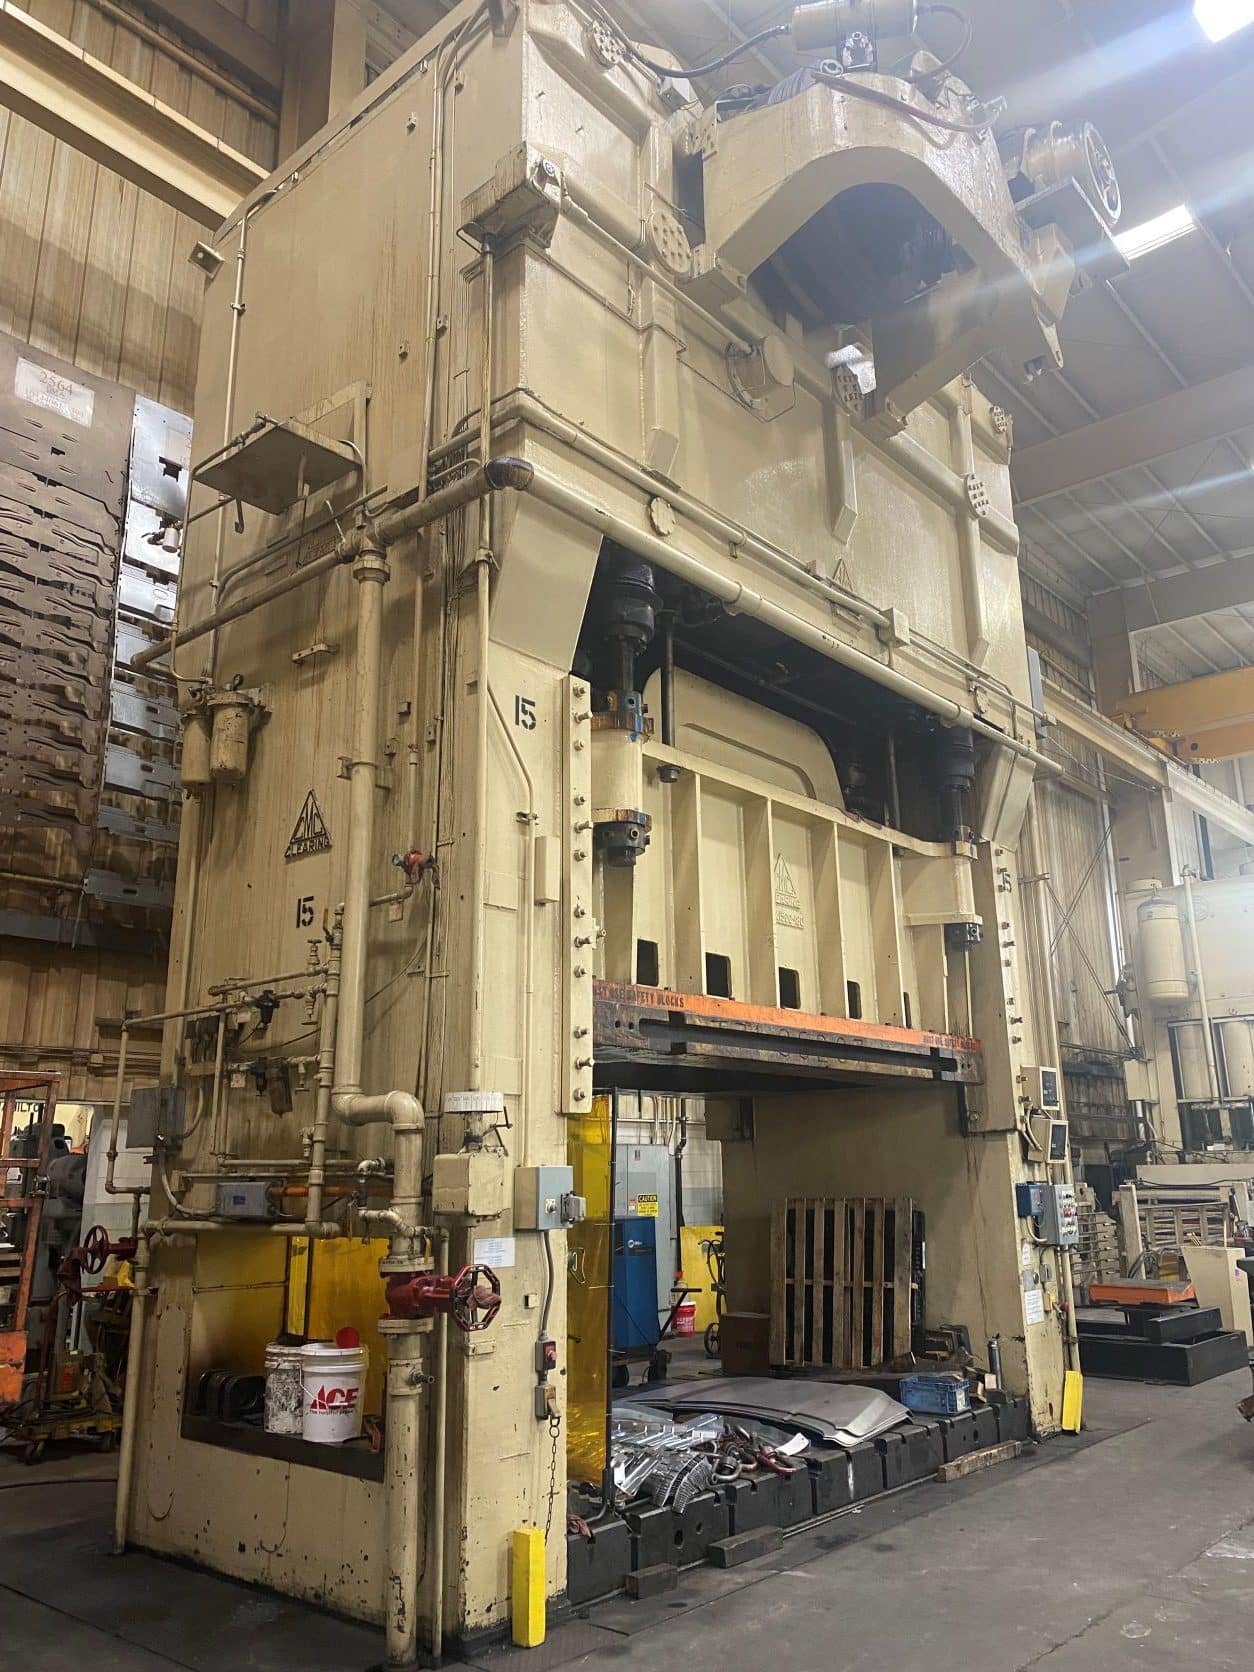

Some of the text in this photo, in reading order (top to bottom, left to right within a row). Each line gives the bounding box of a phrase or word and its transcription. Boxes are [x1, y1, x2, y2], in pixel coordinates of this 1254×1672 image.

[515, 695, 536, 730] 15
[284, 838, 333, 858] CLEARING
[296, 896, 314, 928] 15
[657, 993, 685, 1008] BLOCKS
[311, 1385, 359, 1409] ACE
